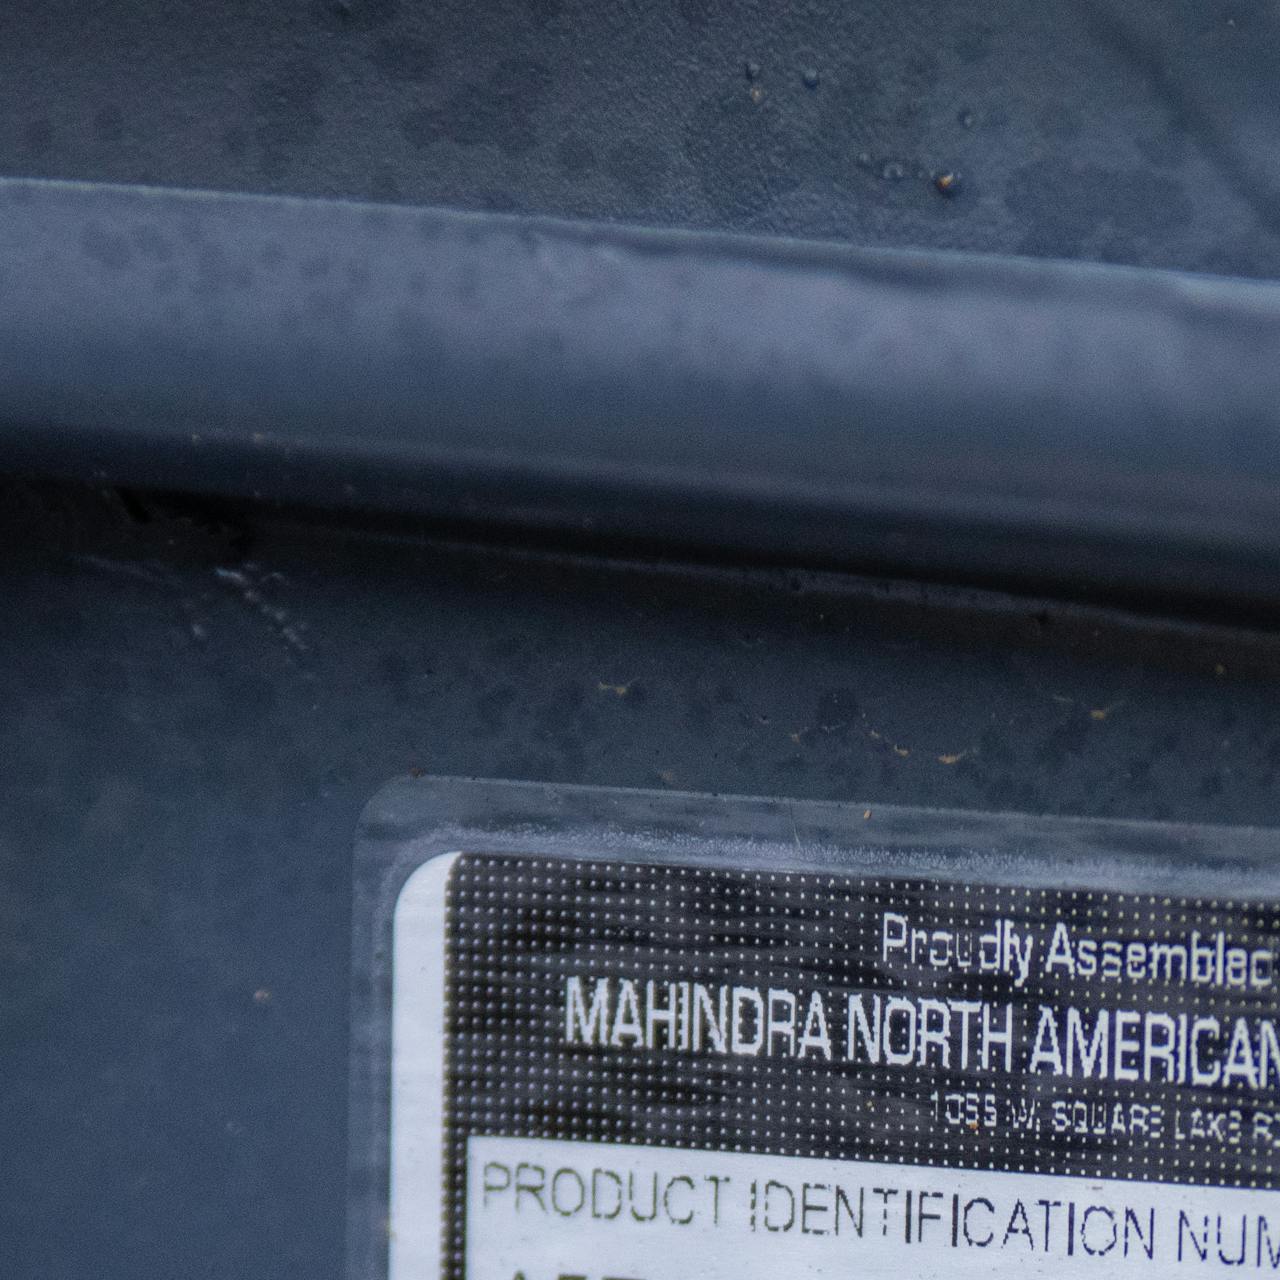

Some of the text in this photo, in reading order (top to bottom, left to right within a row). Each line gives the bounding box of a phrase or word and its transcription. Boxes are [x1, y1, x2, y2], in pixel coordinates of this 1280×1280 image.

[883, 912, 1033, 987] Proudly
[565, 976, 832, 1060] MAHINDRA
[846, 994, 1014, 1072] NORTH
[1051, 1099, 1162, 1139] SQUARE
[483, 1161, 731, 1226] PRODUCT
[749, 1178, 1155, 1260] IDENTIFICATION
